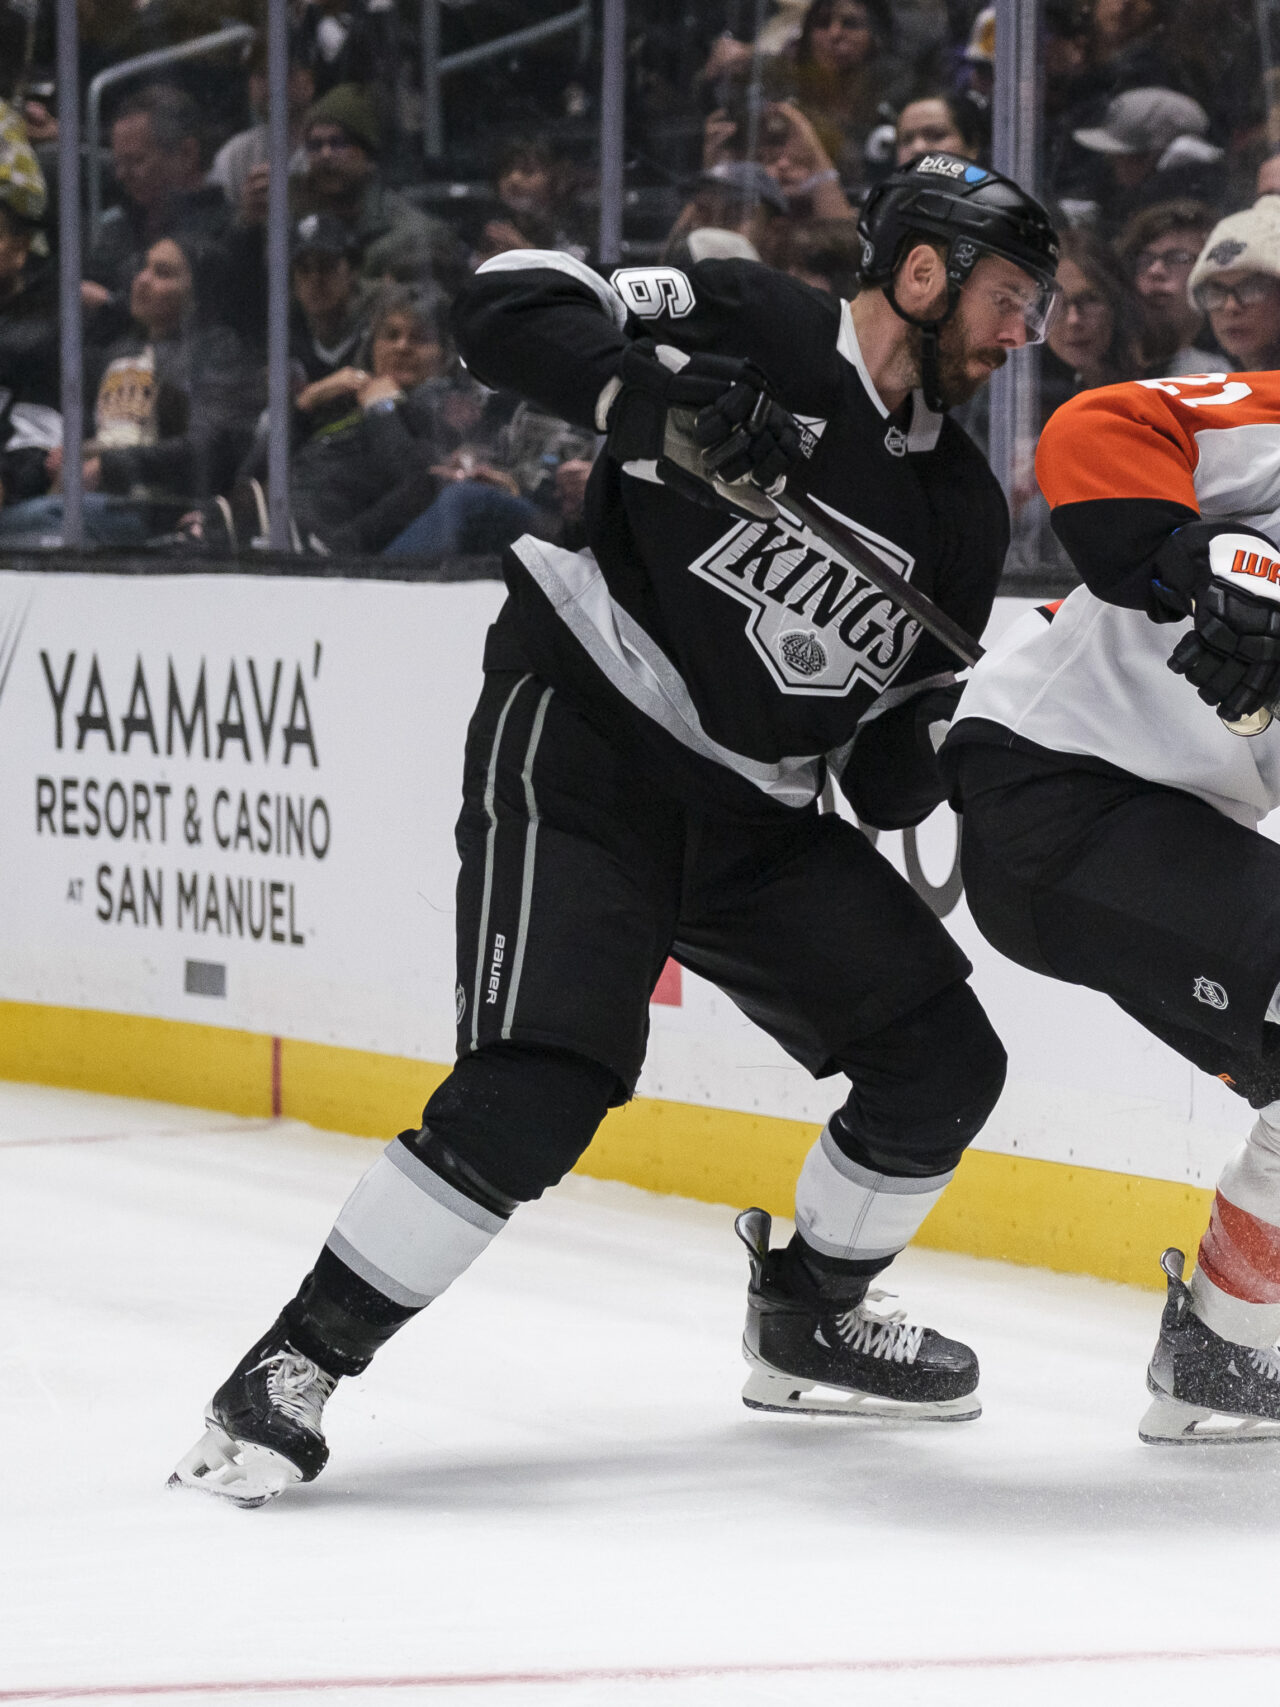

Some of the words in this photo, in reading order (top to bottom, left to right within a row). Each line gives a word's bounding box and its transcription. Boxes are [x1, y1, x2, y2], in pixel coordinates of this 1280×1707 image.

[918, 155, 965, 174] blue
[609, 266, 697, 319] 6
[724, 522, 923, 670] KINGS
[36, 776, 171, 843] RESORT
[184, 784, 202, 845] &
[213, 787, 331, 860] CASINO
[66, 877, 84, 904] AT
[96, 861, 163, 930] SAN
[176, 868, 305, 947] MANUEL
